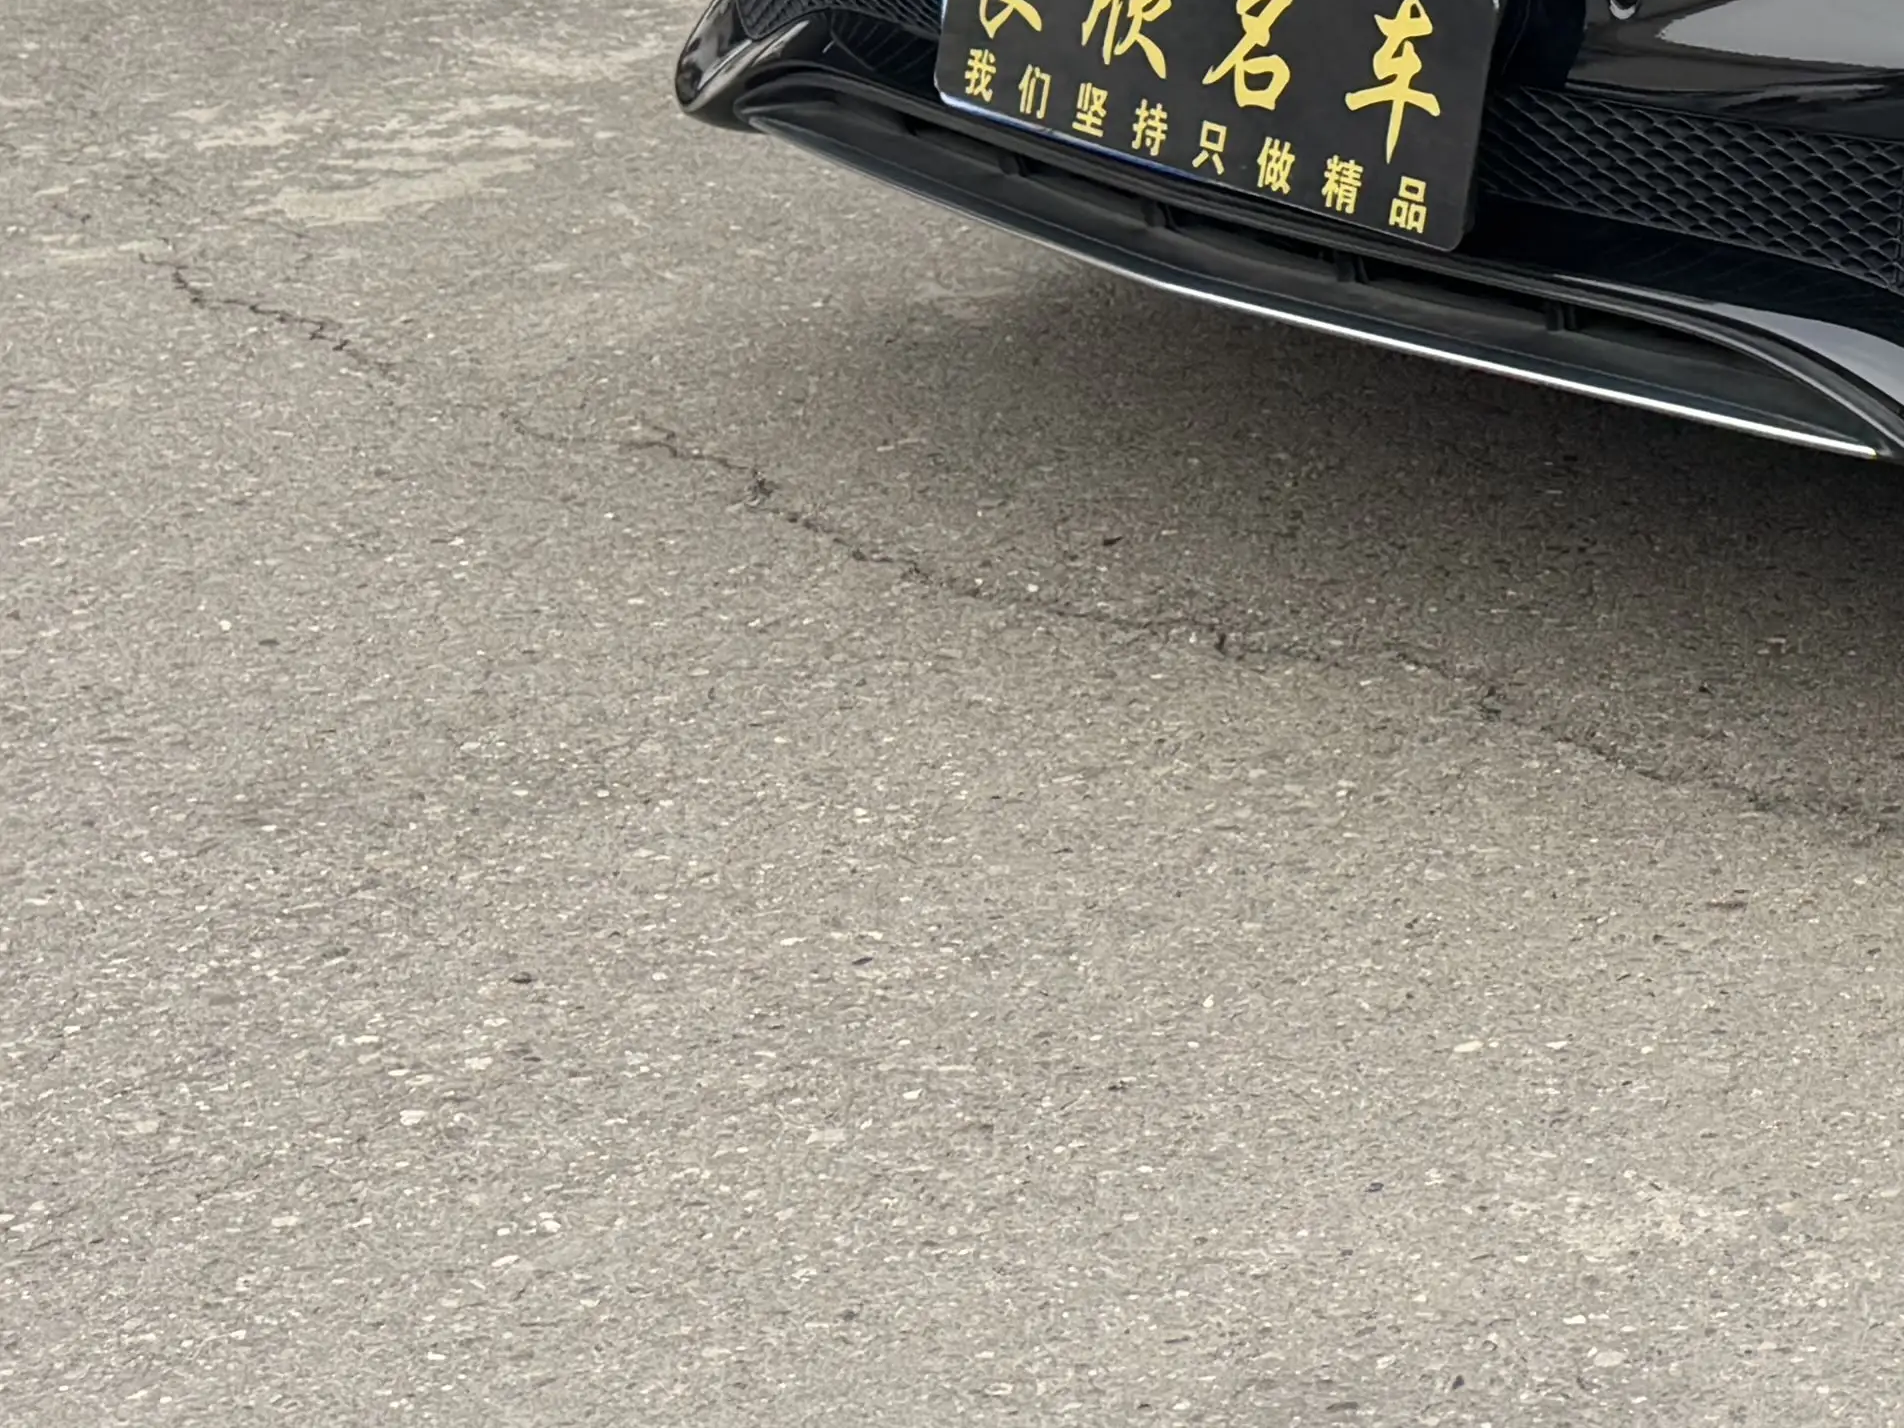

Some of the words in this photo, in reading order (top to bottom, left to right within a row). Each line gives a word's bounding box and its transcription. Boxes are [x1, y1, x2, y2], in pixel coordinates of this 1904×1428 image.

[965, 48, 1428, 234] 我们坚持只做精品
